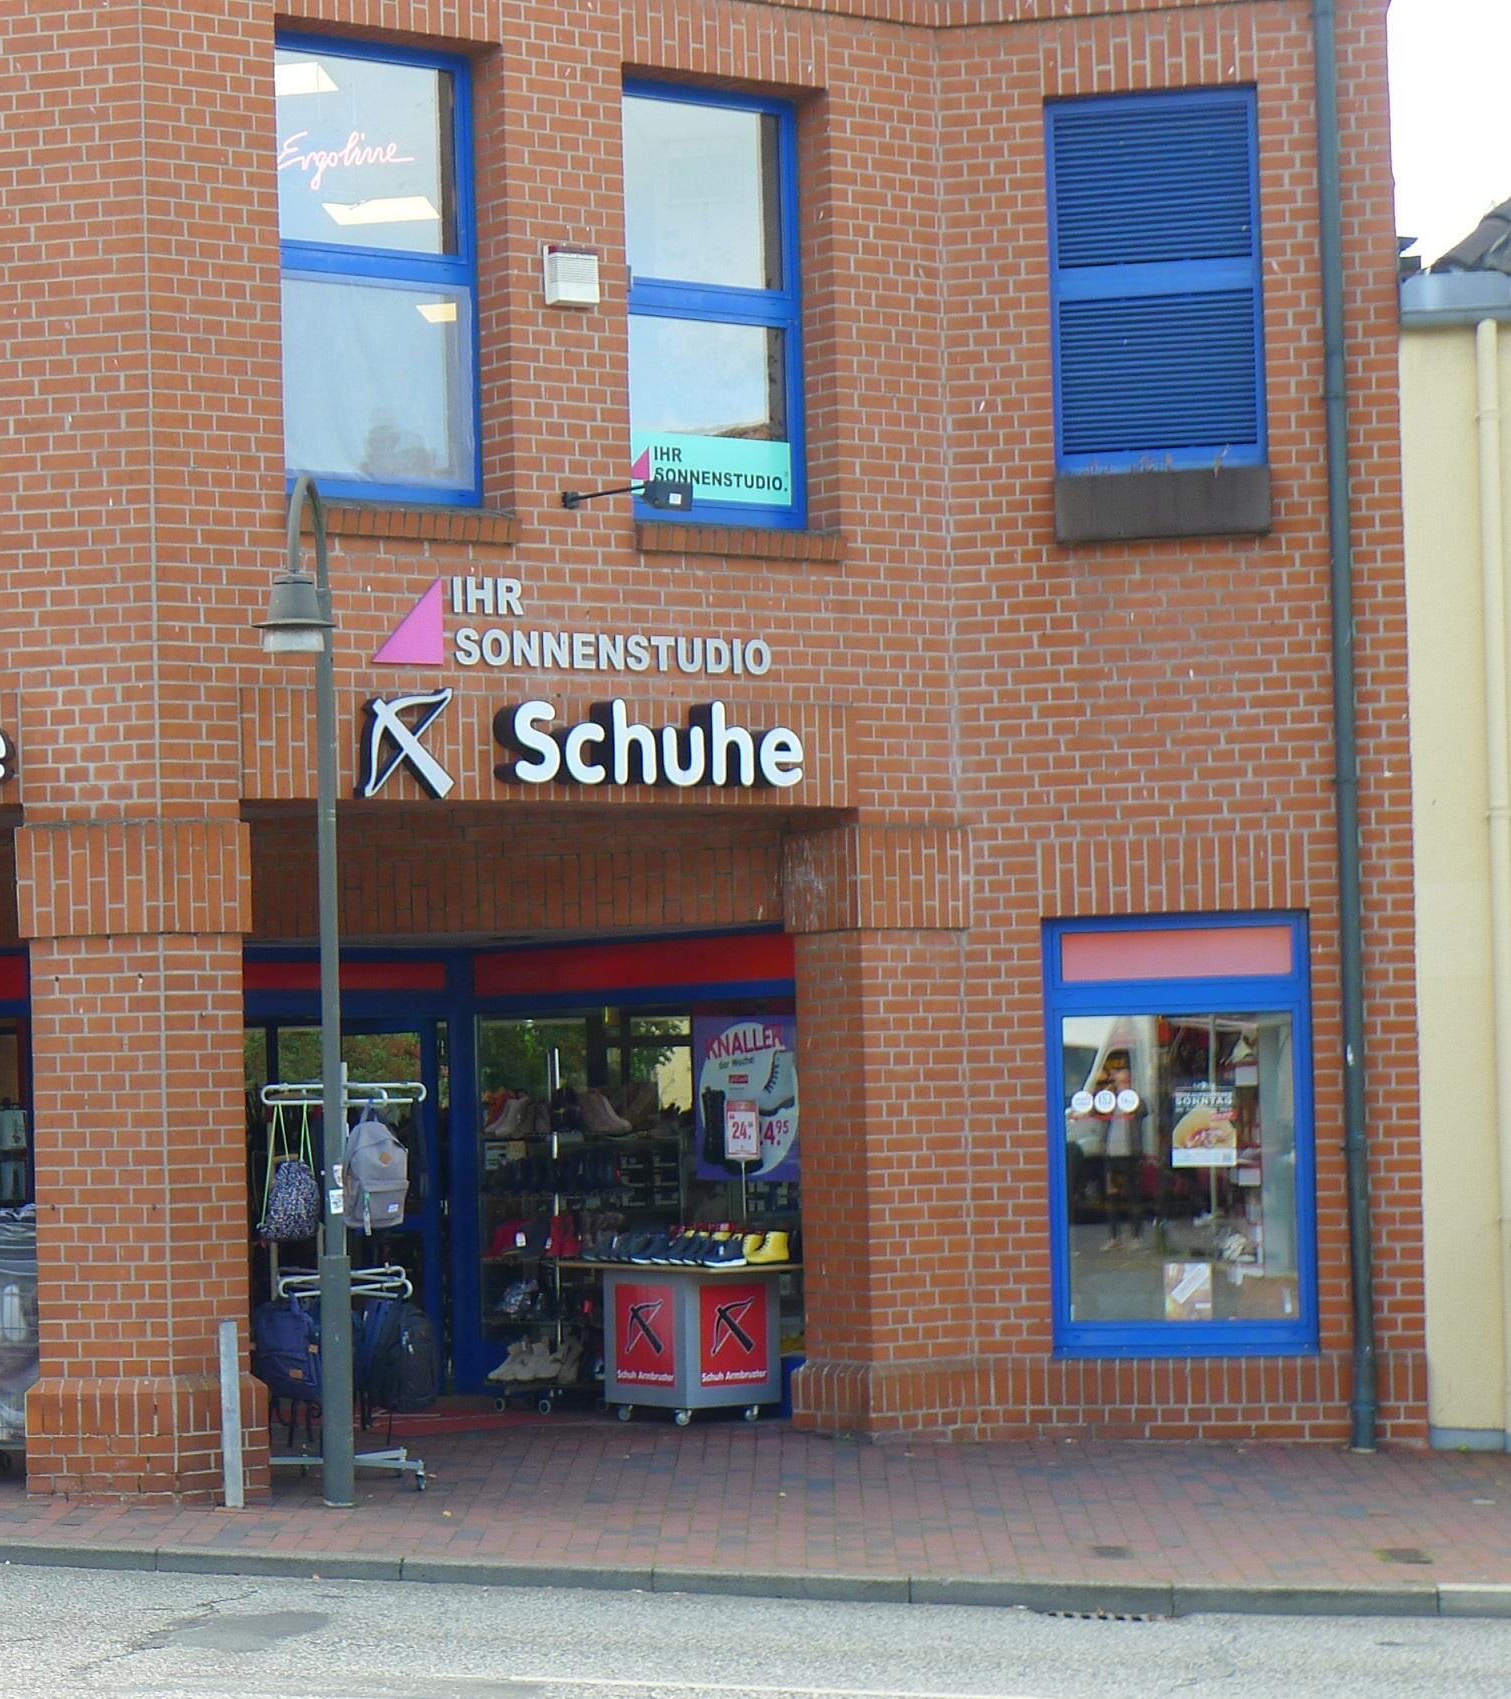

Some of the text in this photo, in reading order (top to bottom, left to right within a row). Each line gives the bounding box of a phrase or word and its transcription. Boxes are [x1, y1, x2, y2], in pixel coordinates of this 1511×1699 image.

[277, 130, 416, 191] Ergoline
[653, 446, 683, 463] IHR
[451, 575, 525, 616] IHR
[453, 626, 773, 676] SONNENSTUDIO
[510, 697, 805, 788] Schuhe
[705, 1024, 785, 1060] KNALLER
[1175, 1095, 1233, 1105] SONNTAG
[701, 1371, 725, 1383] Schuh
